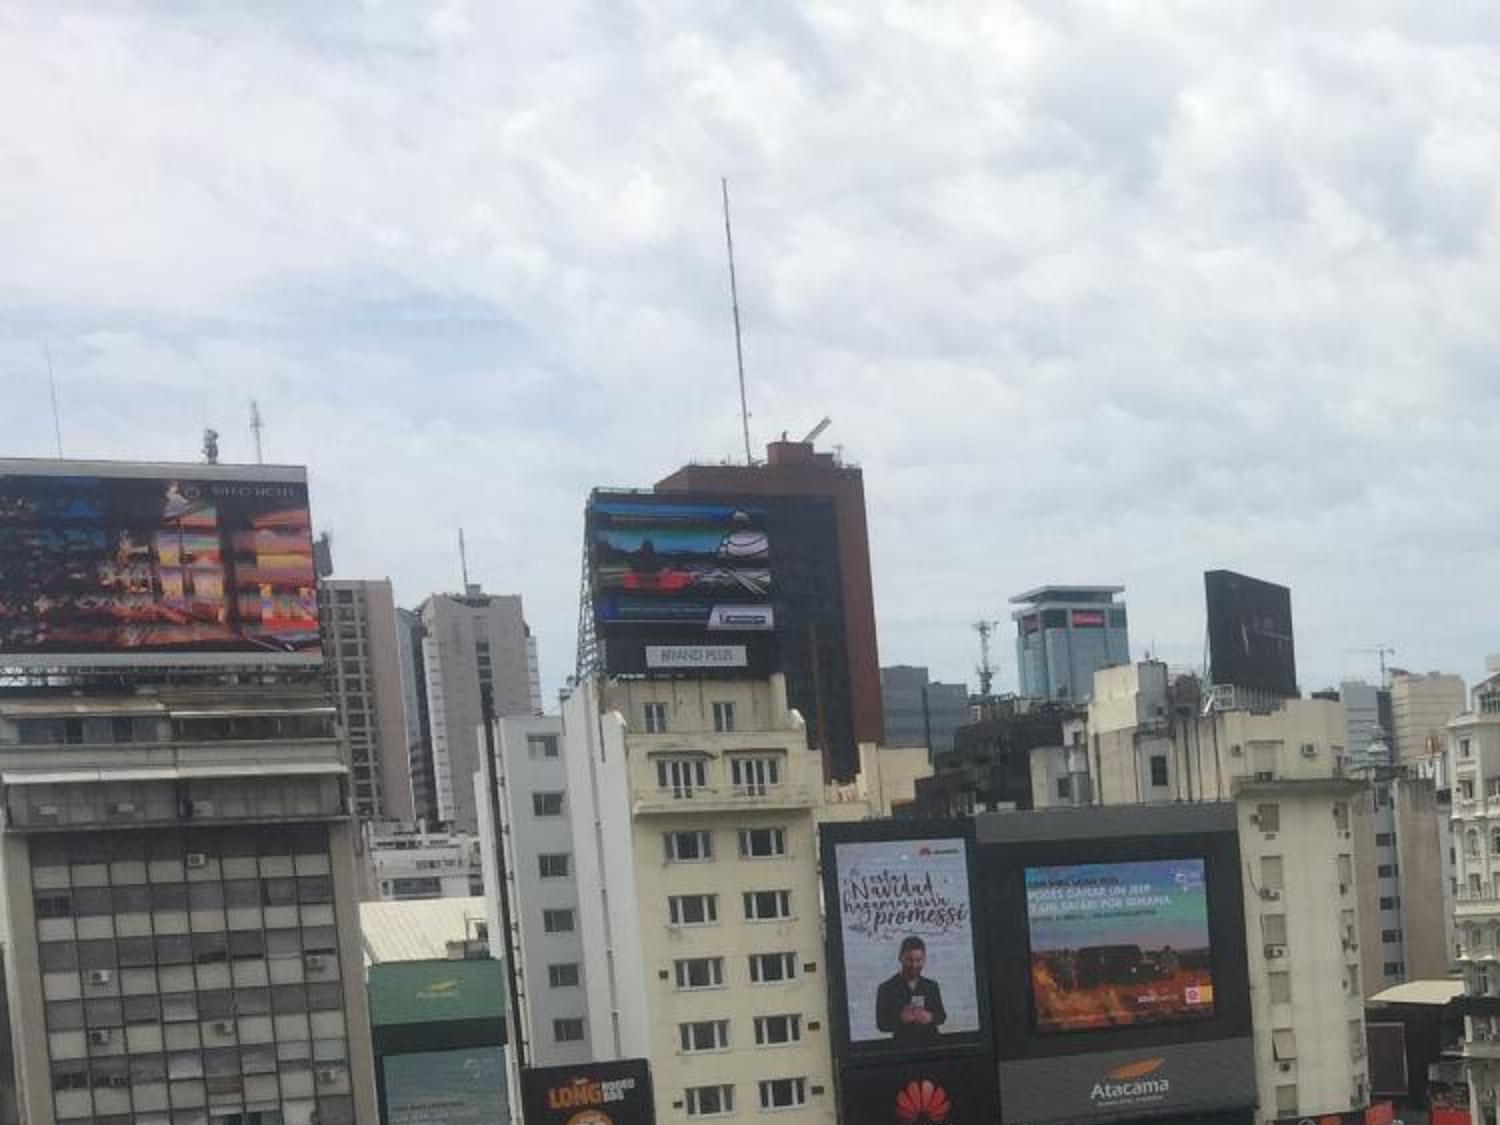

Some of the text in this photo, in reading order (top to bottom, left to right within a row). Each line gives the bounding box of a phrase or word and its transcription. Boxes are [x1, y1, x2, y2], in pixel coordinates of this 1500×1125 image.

[851, 871, 934, 900] Navidad
[550, 1084, 600, 1108] LONG
[1090, 1078, 1169, 1100] Atacama
